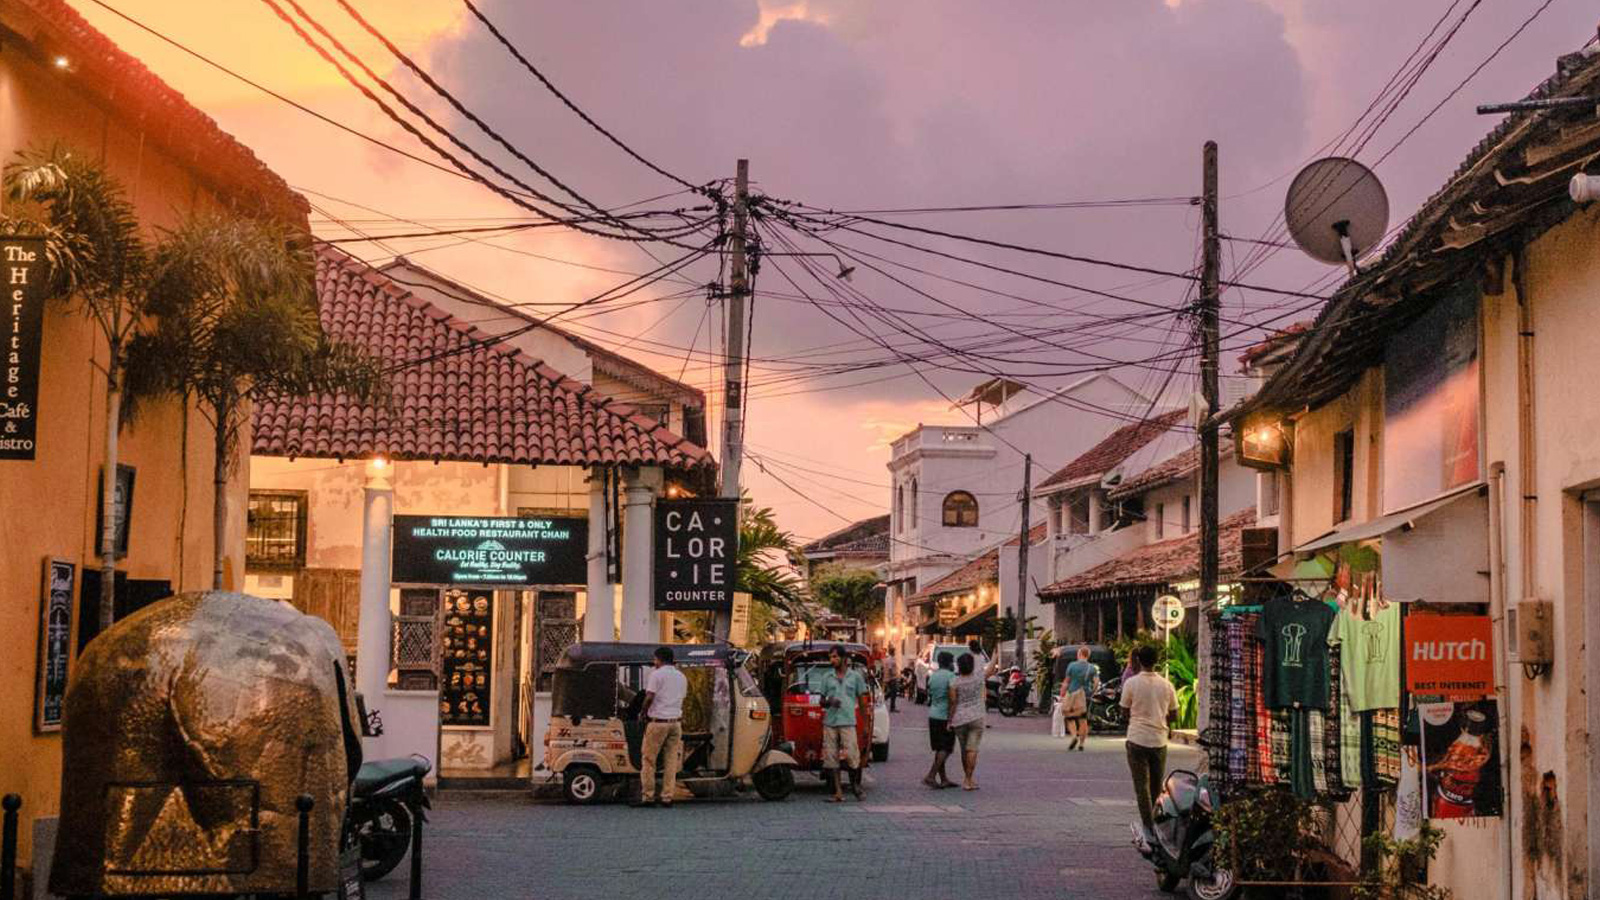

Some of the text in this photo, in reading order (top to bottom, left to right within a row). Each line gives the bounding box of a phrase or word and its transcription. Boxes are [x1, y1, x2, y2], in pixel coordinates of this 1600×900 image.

[4, 246, 36, 262] The
[8, 267, 29, 398] Heritage
[4, 420, 19, 433] &
[0, 435, 33, 450] istro
[431, 518, 552, 529] SRI LANKA'S FIRST & ONLY
[413, 528, 569, 540] HEALTH FOOD RESTAURANT CHAIN
[436, 550, 545, 562] CALORIE COUNTER
[666, 591, 725, 601] COUNTER
